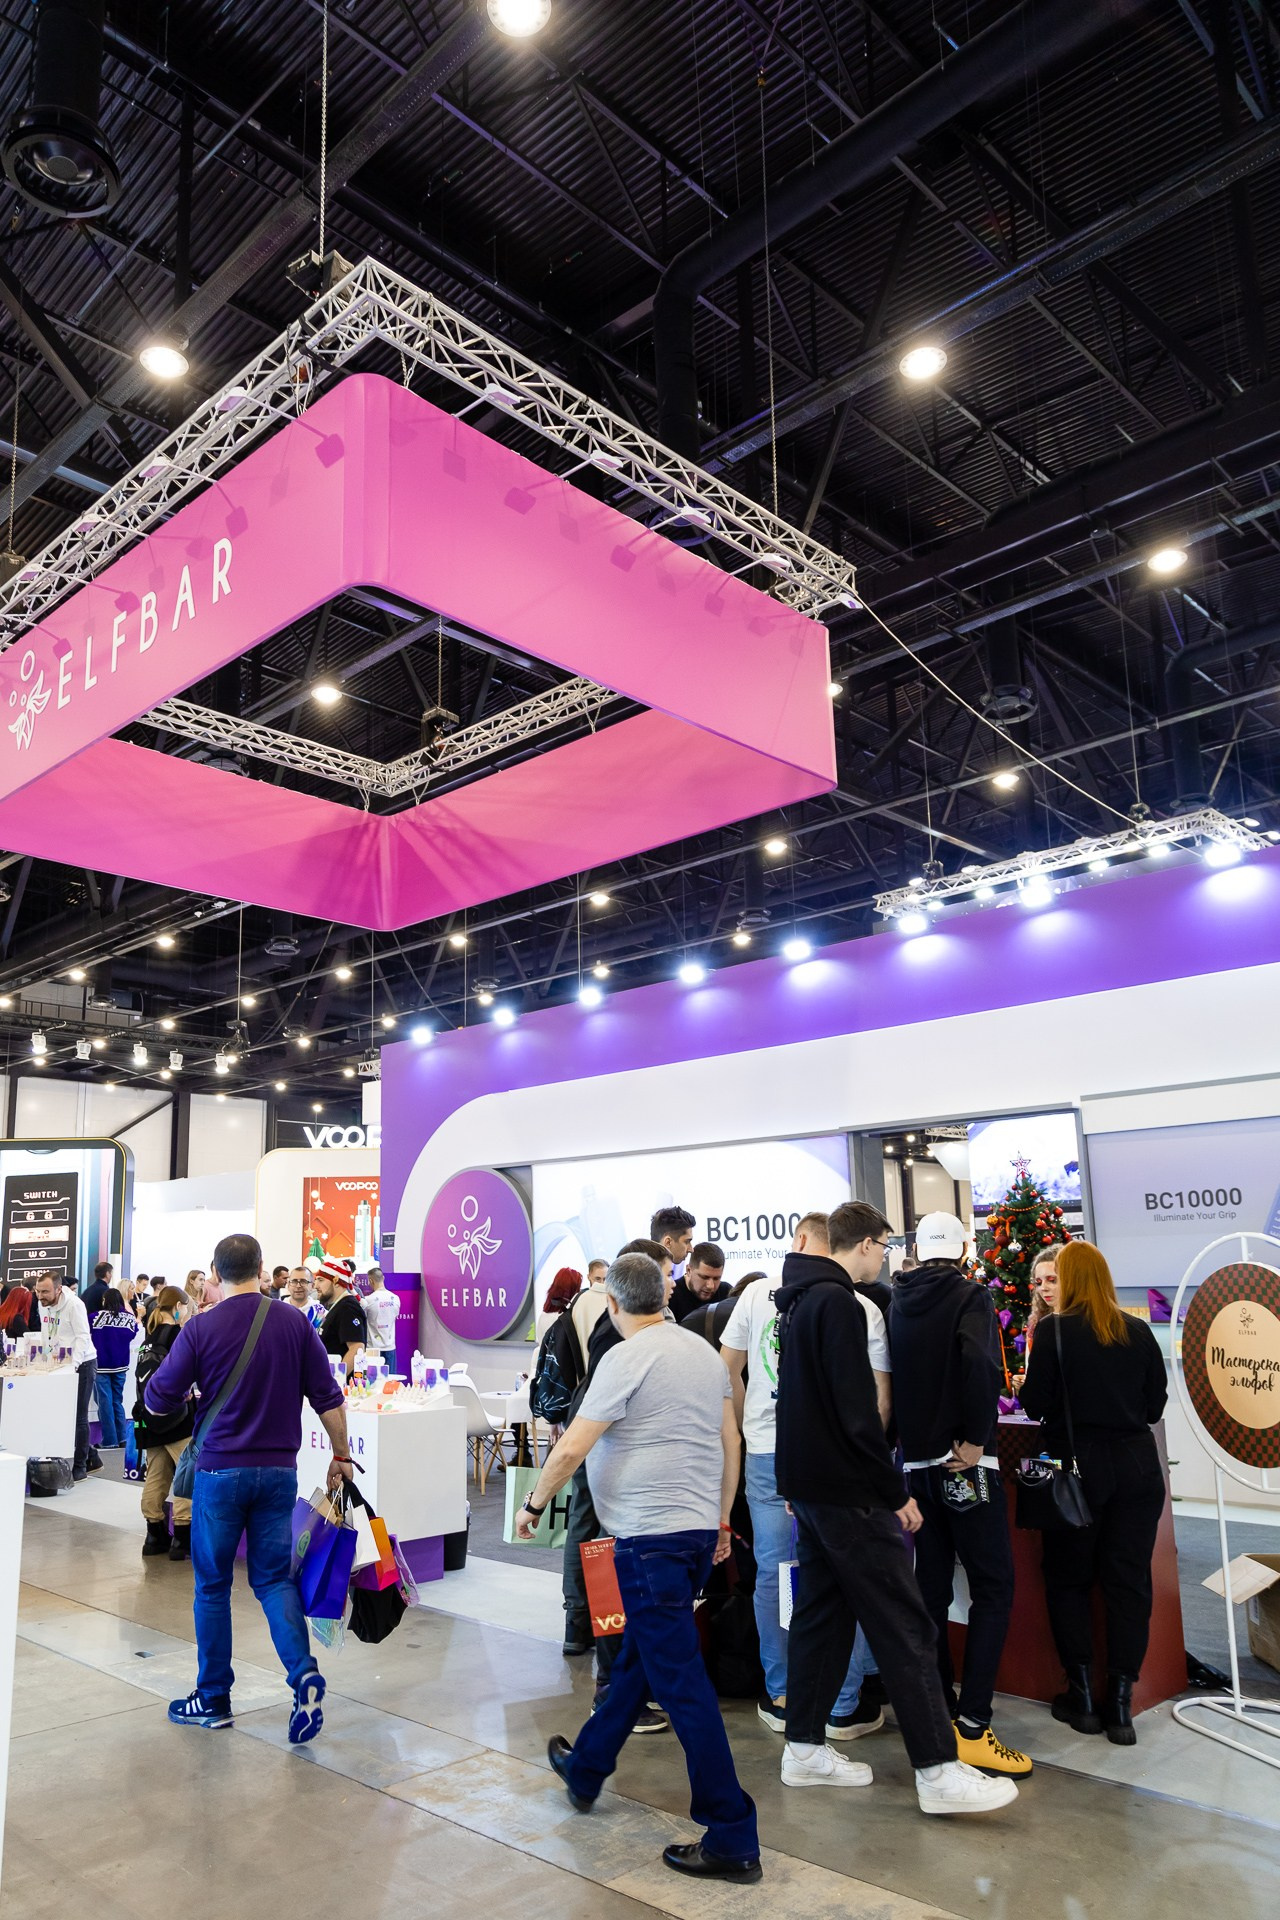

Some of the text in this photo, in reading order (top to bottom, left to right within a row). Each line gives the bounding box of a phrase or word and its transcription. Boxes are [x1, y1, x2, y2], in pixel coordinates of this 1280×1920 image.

[57, 537, 233, 710] ELFBAR
[23, 1190, 58, 1200] SWITCH
[334, 1181, 379, 1191] VOOPOO
[1144, 1187, 1243, 1211] BC10000
[706, 1211, 814, 1242] BC1000
[1153, 1210, 1237, 1222] Illuminate Your Grip
[441, 1287, 507, 1307] ELFBAR
[311, 1431, 364, 1455] ELAR
